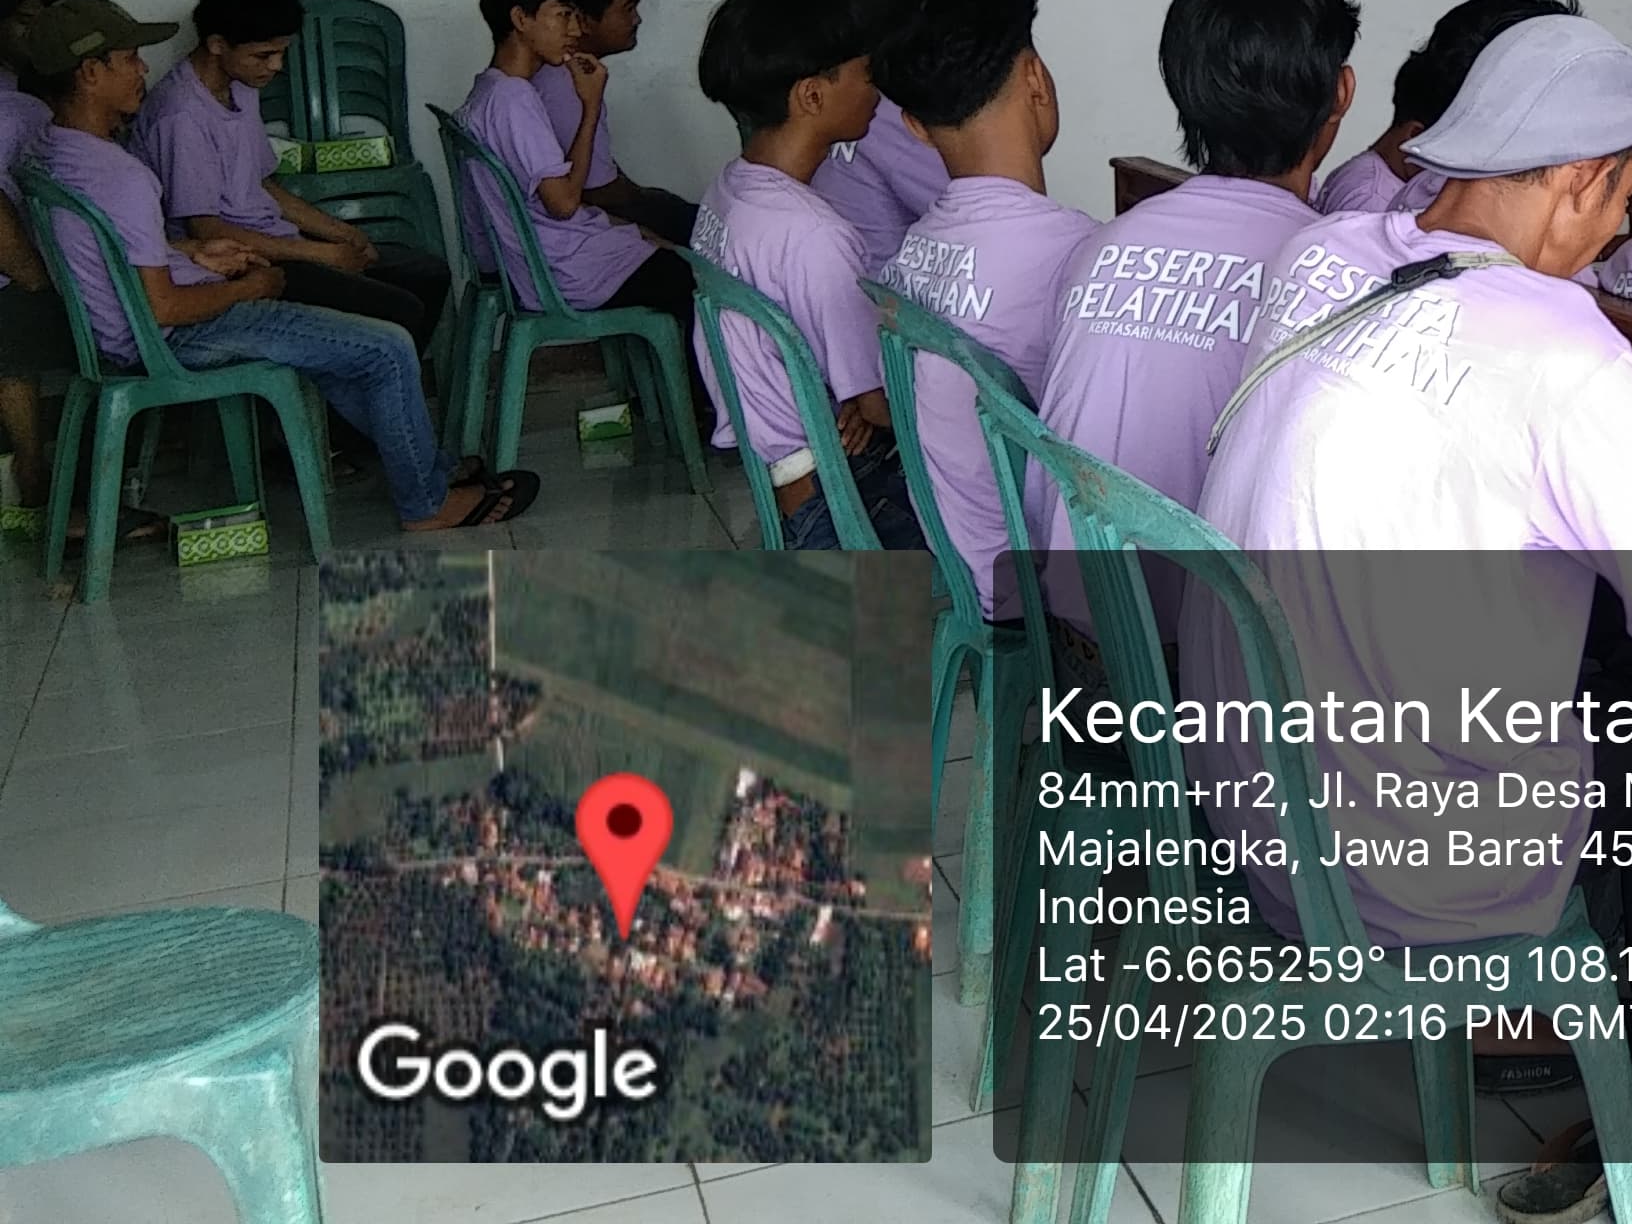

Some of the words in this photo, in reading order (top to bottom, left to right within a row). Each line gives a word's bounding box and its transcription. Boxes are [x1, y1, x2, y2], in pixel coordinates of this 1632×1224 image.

[1090, 245, 1265, 299] PESERTA
[1089, 321, 1152, 339] KERTASARI
[1154, 330, 1215, 352] MAKMUR
